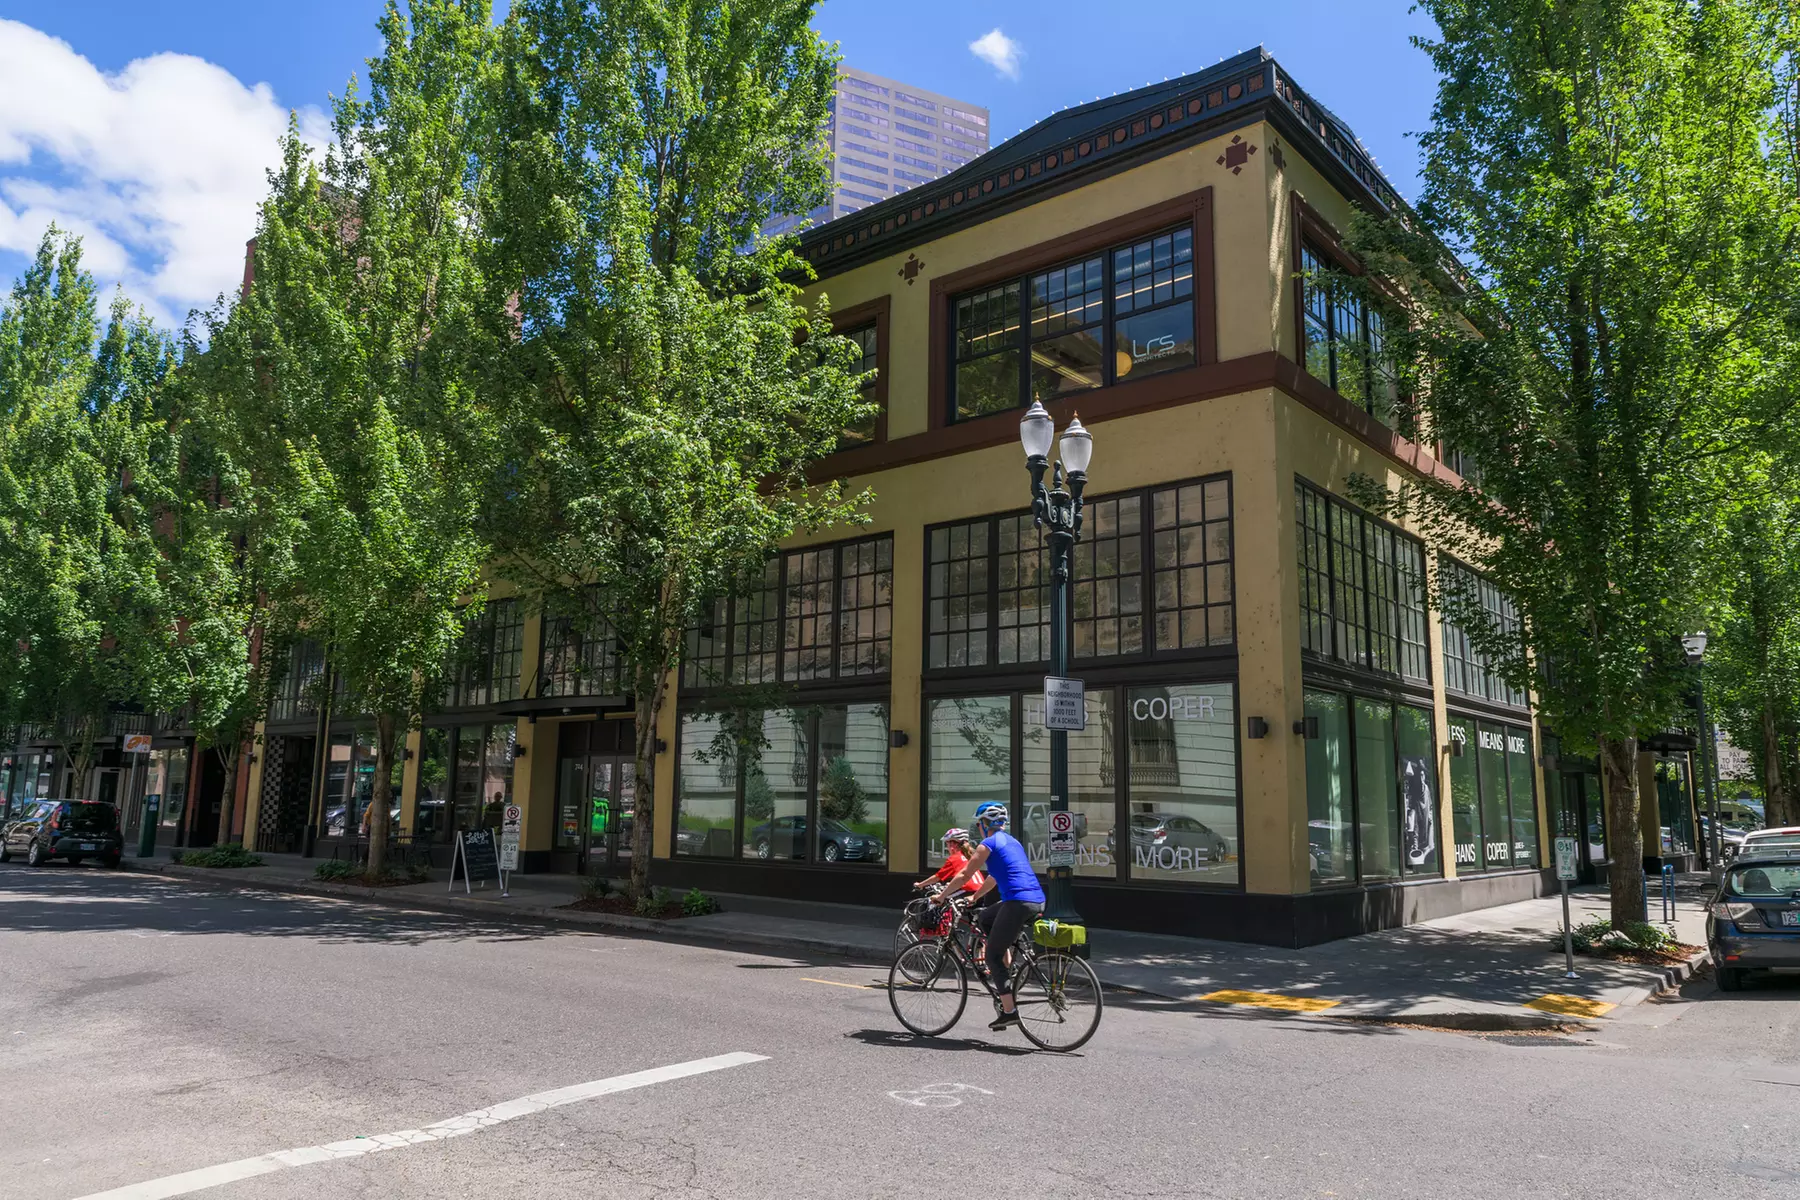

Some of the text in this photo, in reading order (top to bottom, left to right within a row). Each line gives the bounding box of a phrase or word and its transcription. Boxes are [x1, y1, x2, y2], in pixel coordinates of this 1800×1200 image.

[1047, 690, 1082, 699] NEIGHBORHOOD
[1060, 682, 1070, 690] THIS
[1133, 695, 1215, 721] COPER
[1061, 717, 1080, 725] SCHOOL
[1479, 731, 1504, 751] MEANS
[1507, 735, 1526, 754] MORE
[1027, 842, 1110, 867] MNS
[1135, 845, 1209, 871] MORE
[1454, 843, 1476, 862] HANS
[1487, 842, 1509, 861] COPER
